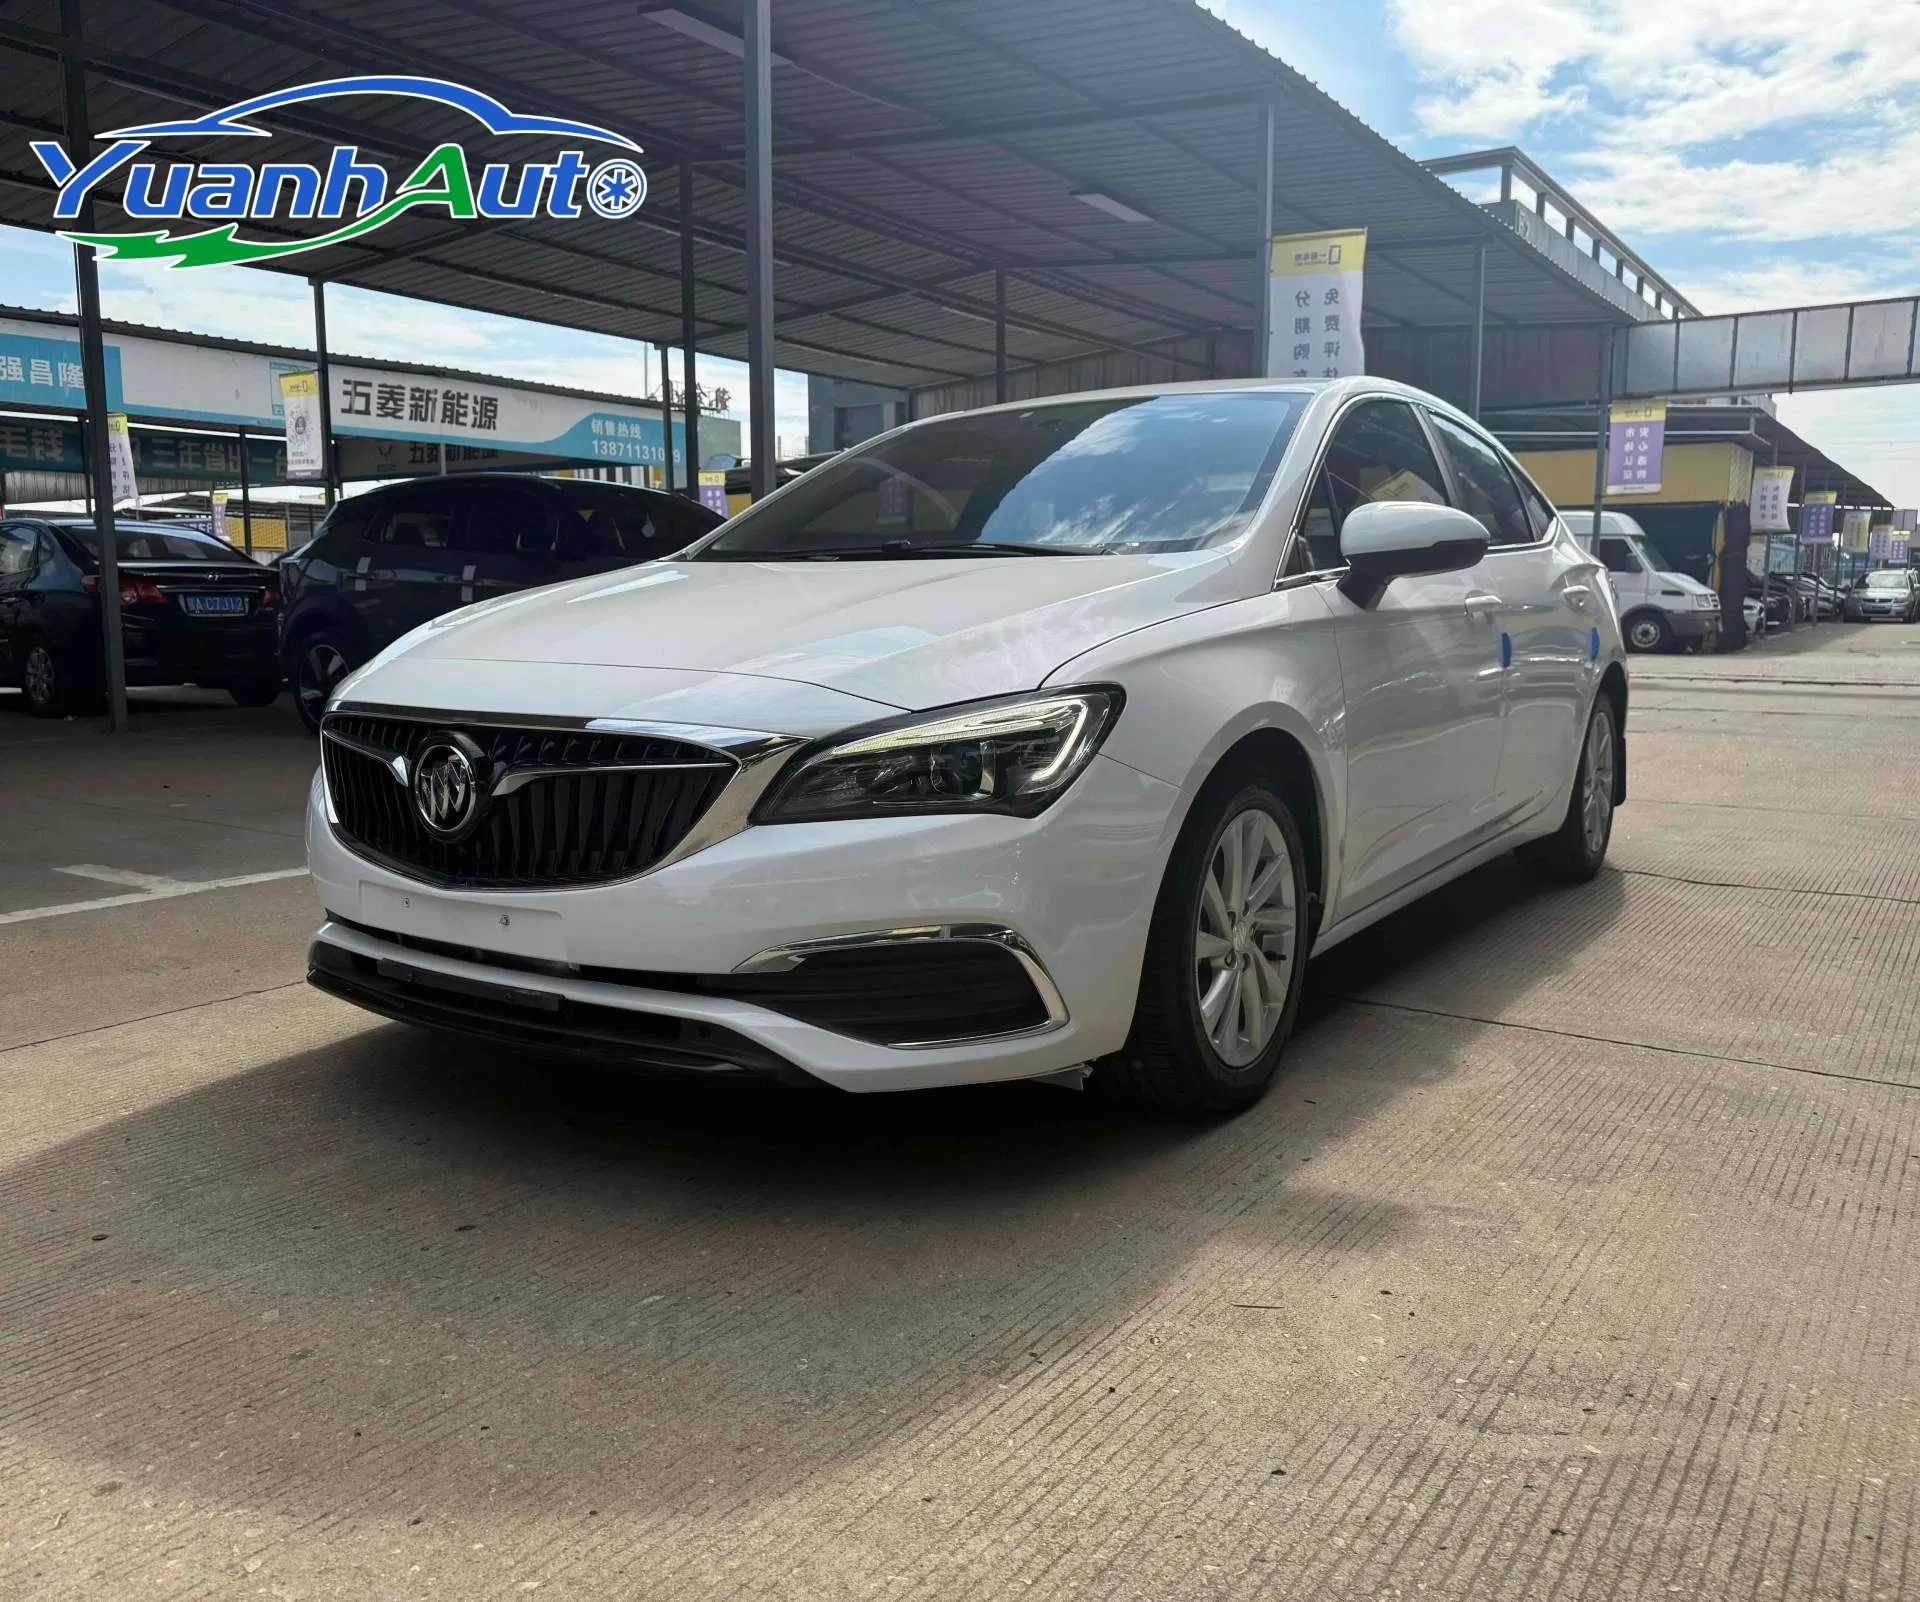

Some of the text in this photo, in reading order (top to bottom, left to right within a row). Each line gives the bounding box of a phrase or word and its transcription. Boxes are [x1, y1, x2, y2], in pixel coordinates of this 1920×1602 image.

[341, 379, 499, 430] 五菱新能源
[592, 440, 681, 463] 1387113109
